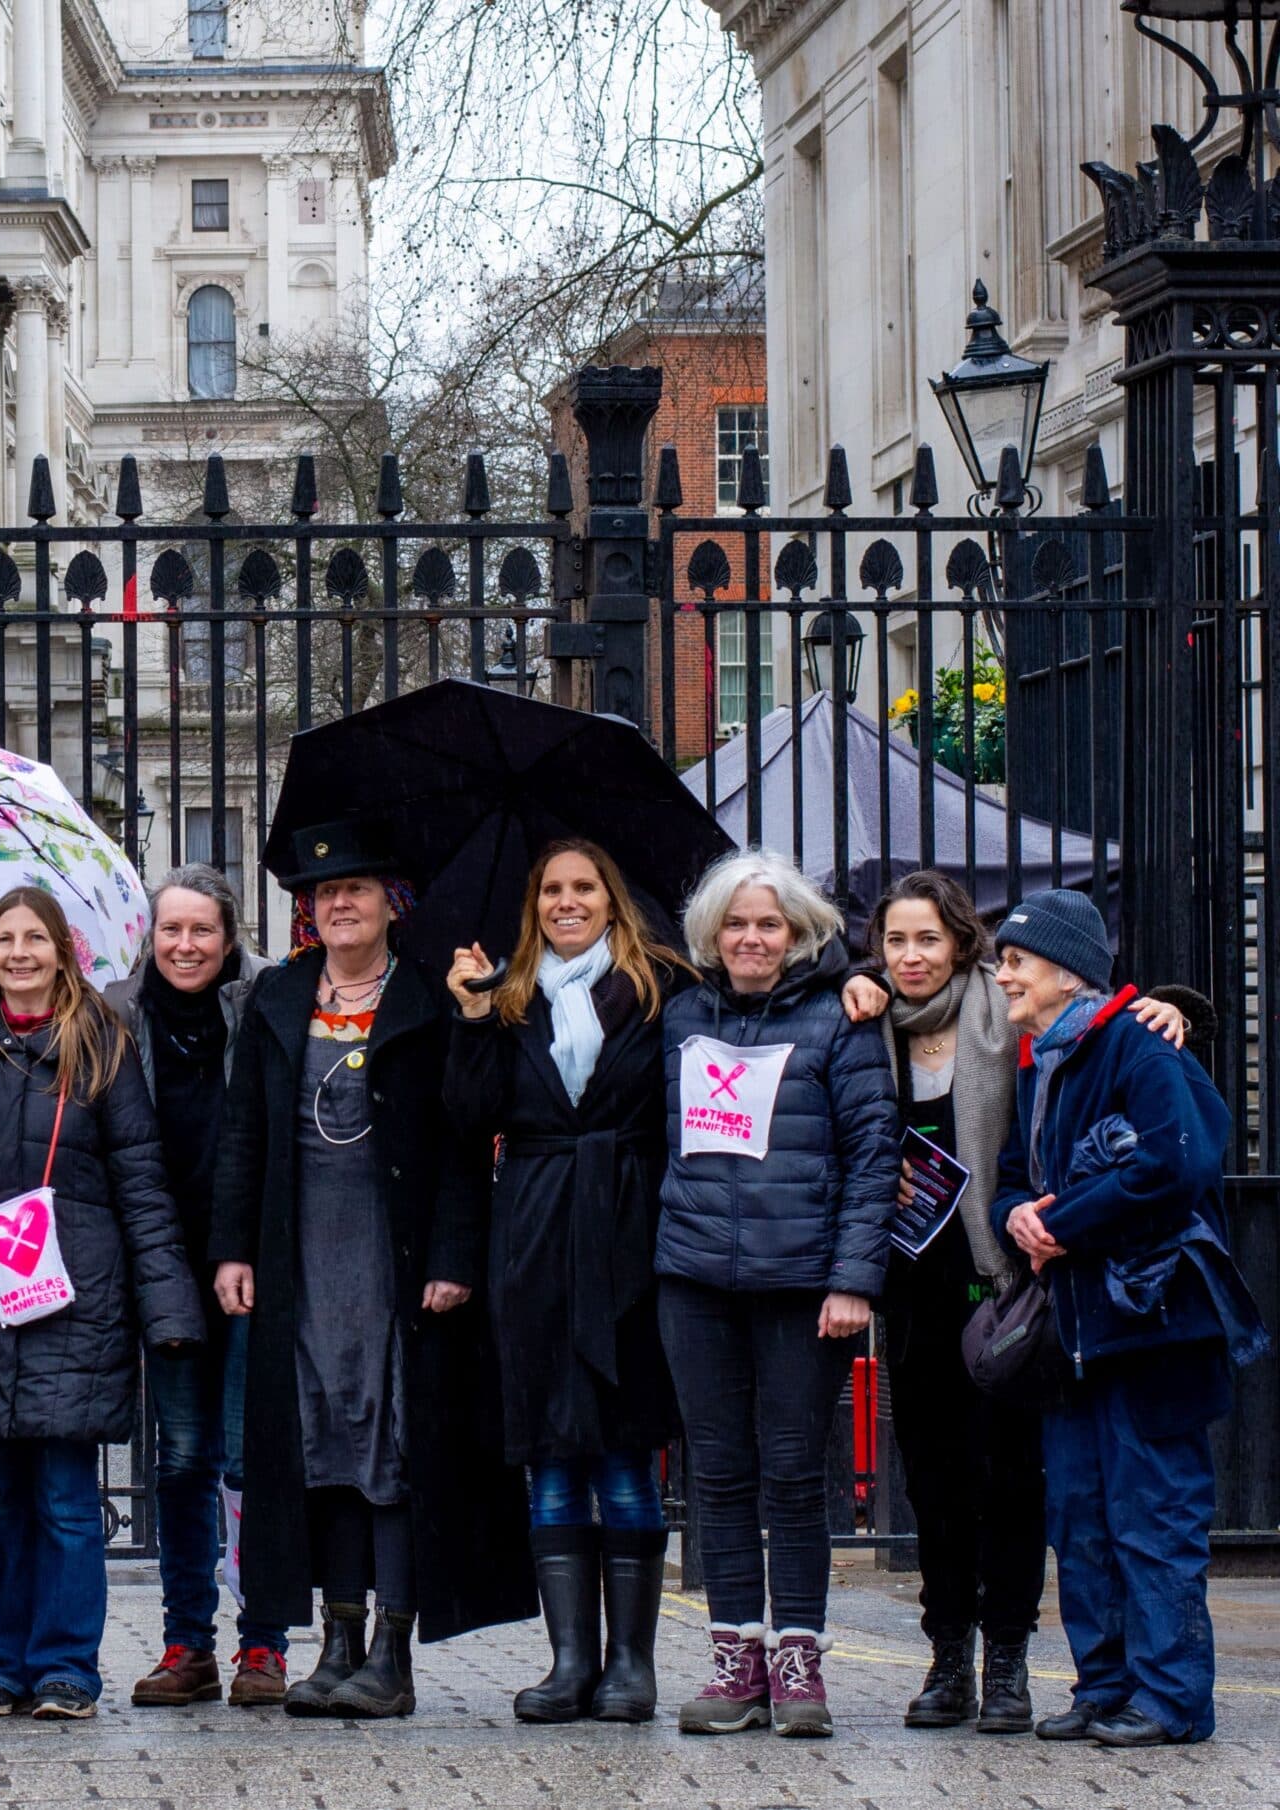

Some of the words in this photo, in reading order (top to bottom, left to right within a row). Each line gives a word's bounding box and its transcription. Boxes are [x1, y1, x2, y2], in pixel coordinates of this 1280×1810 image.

[684, 1119, 751, 1140] MANIFESTO
[687, 1106, 753, 1129] MOTHERS
[0, 1276, 65, 1306] MOTHERS
[3, 1289, 68, 1317] MANIFESTO
